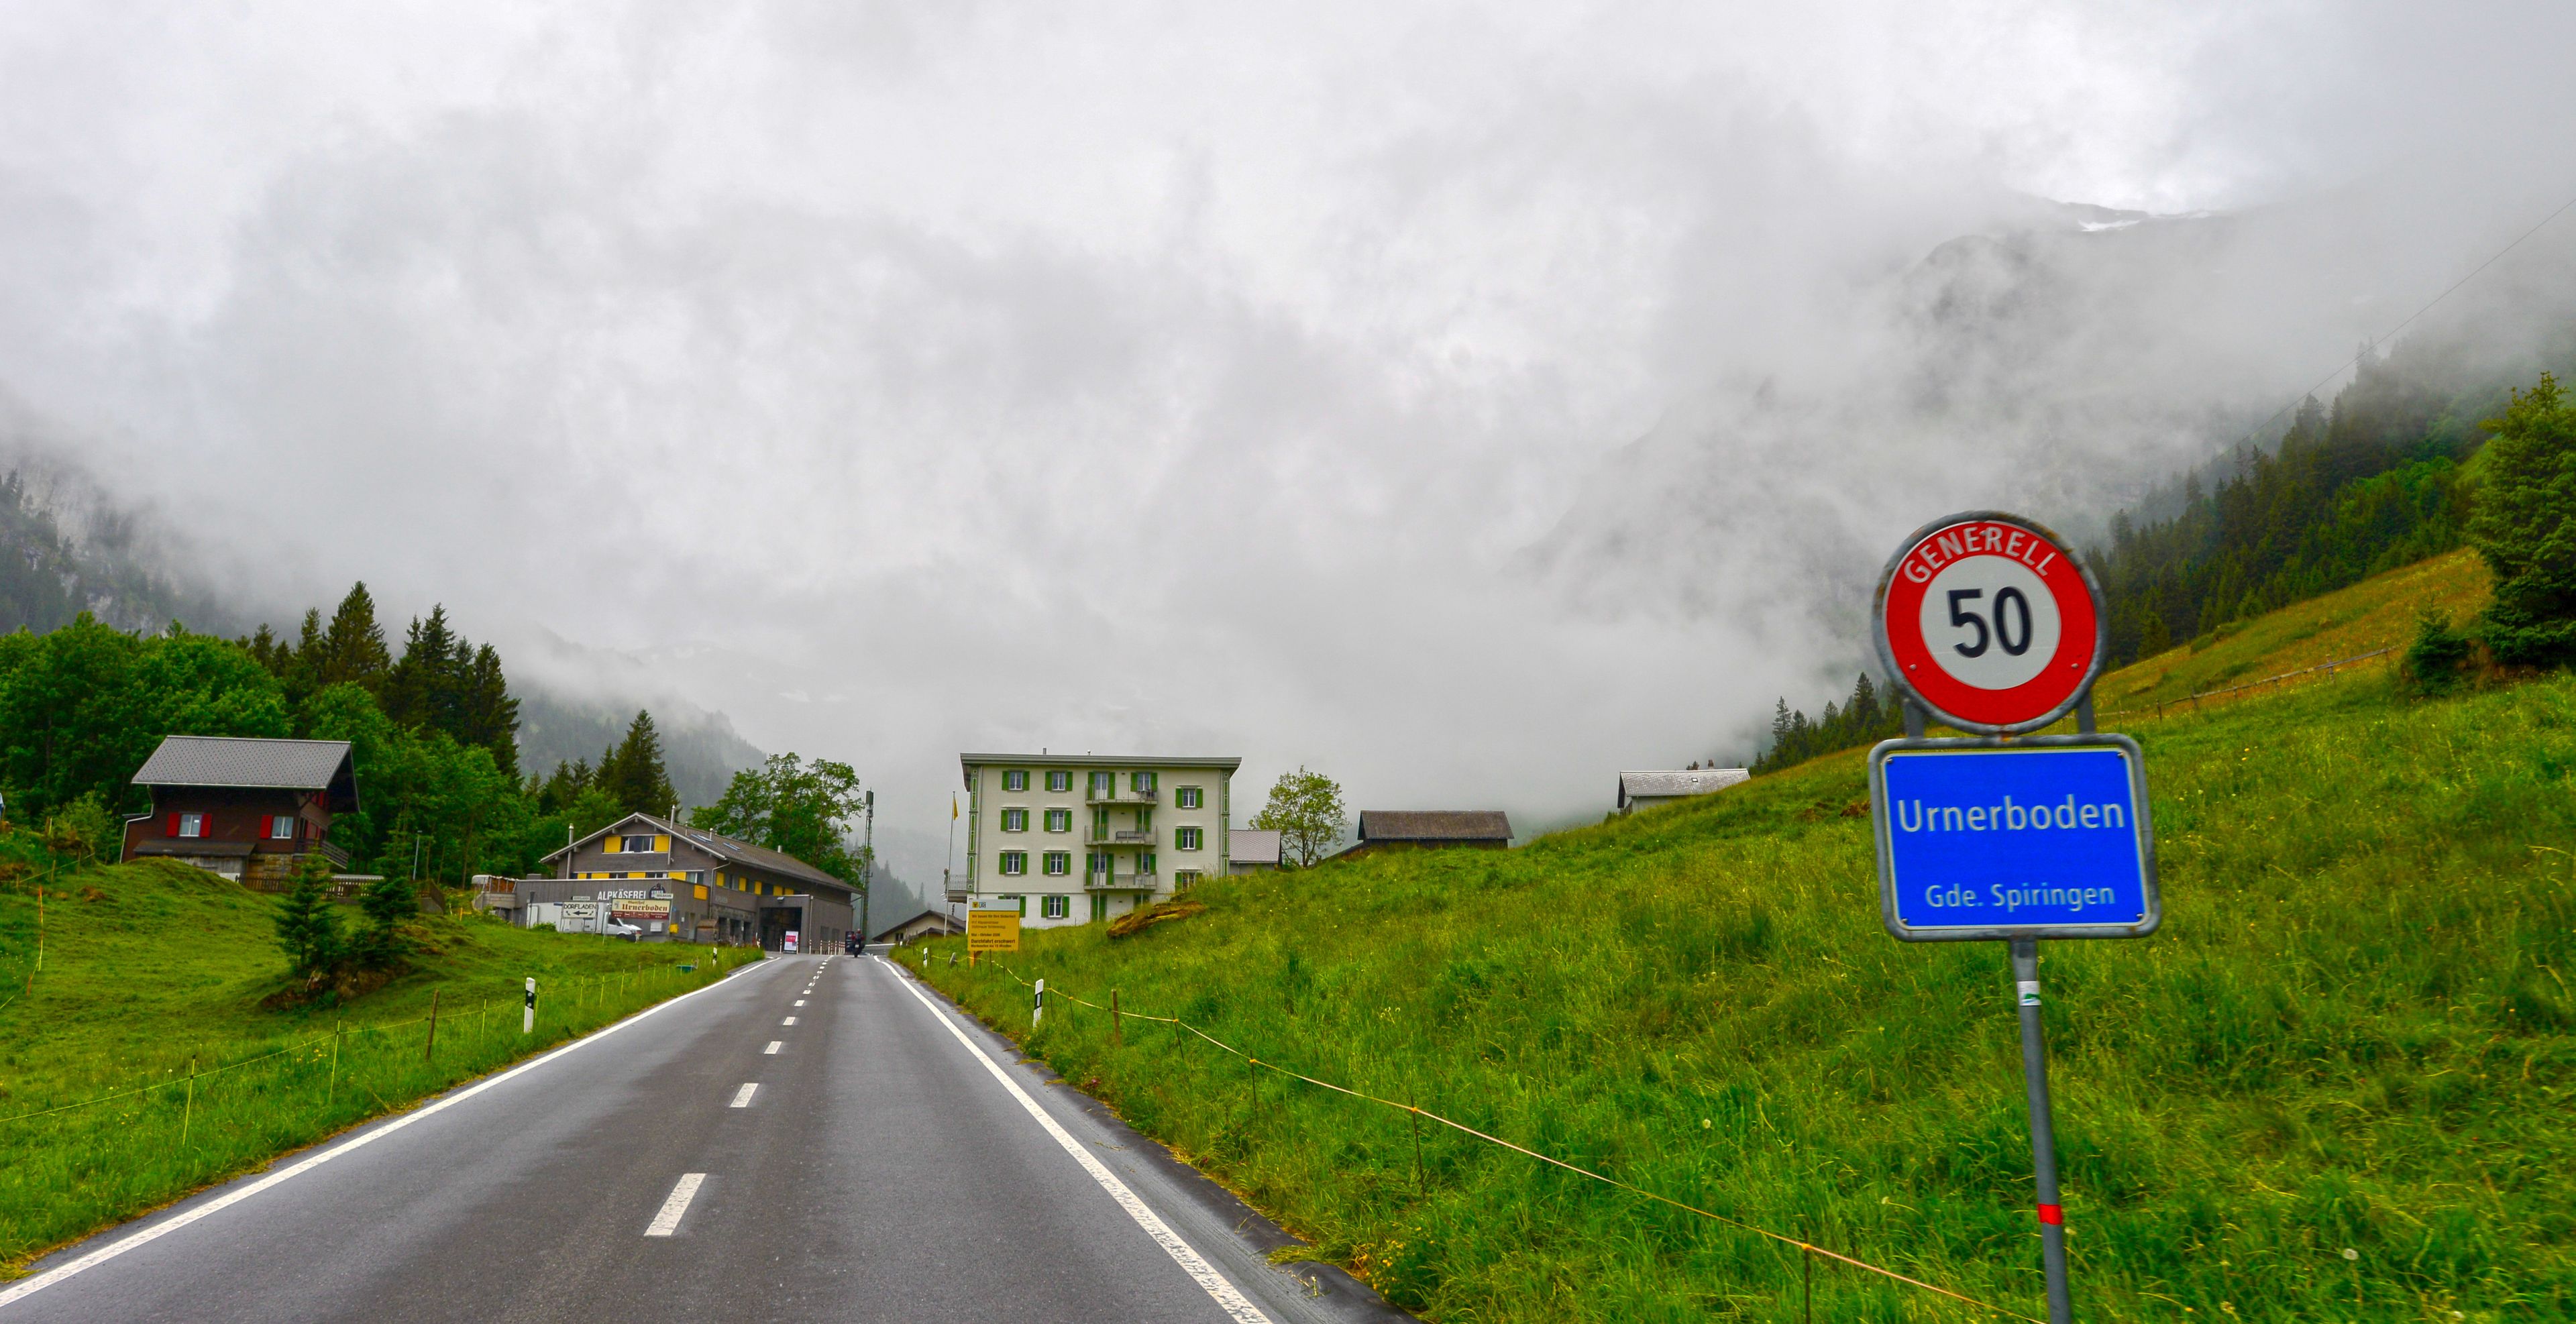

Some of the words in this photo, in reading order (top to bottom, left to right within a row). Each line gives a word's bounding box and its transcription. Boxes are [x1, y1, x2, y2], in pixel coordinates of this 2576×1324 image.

[1904, 527, 2057, 583] GENERELL
[1947, 586, 2034, 658] 50
[1898, 794, 2125, 832] Urnerboden
[597, 889, 645, 900] ALPKÄSEREI
[622, 903, 667, 912] Urnerboden
[1925, 883, 1984, 907] Gde.
[1990, 882, 2115, 912] Spiringen
